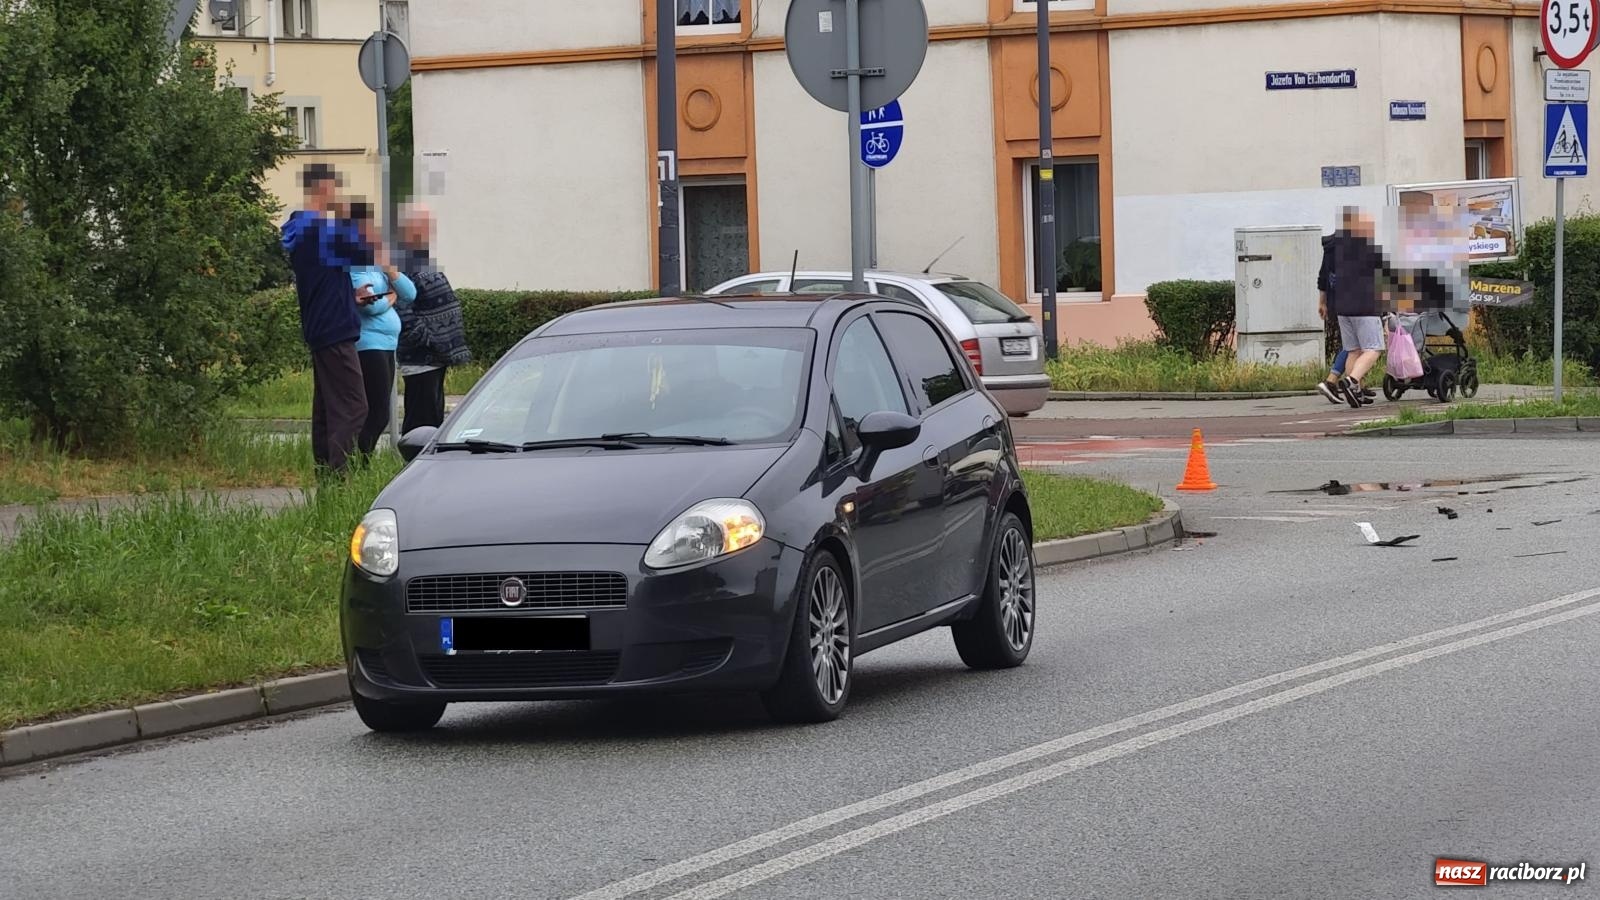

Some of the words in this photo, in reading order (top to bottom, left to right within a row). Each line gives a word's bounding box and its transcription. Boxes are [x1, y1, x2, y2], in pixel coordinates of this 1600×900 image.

[1549, 1, 1590, 38] 3,5t
[1469, 242, 1499, 252] yskiego
[1470, 280, 1521, 295] Marzena
[505, 586, 519, 598] FIAT
